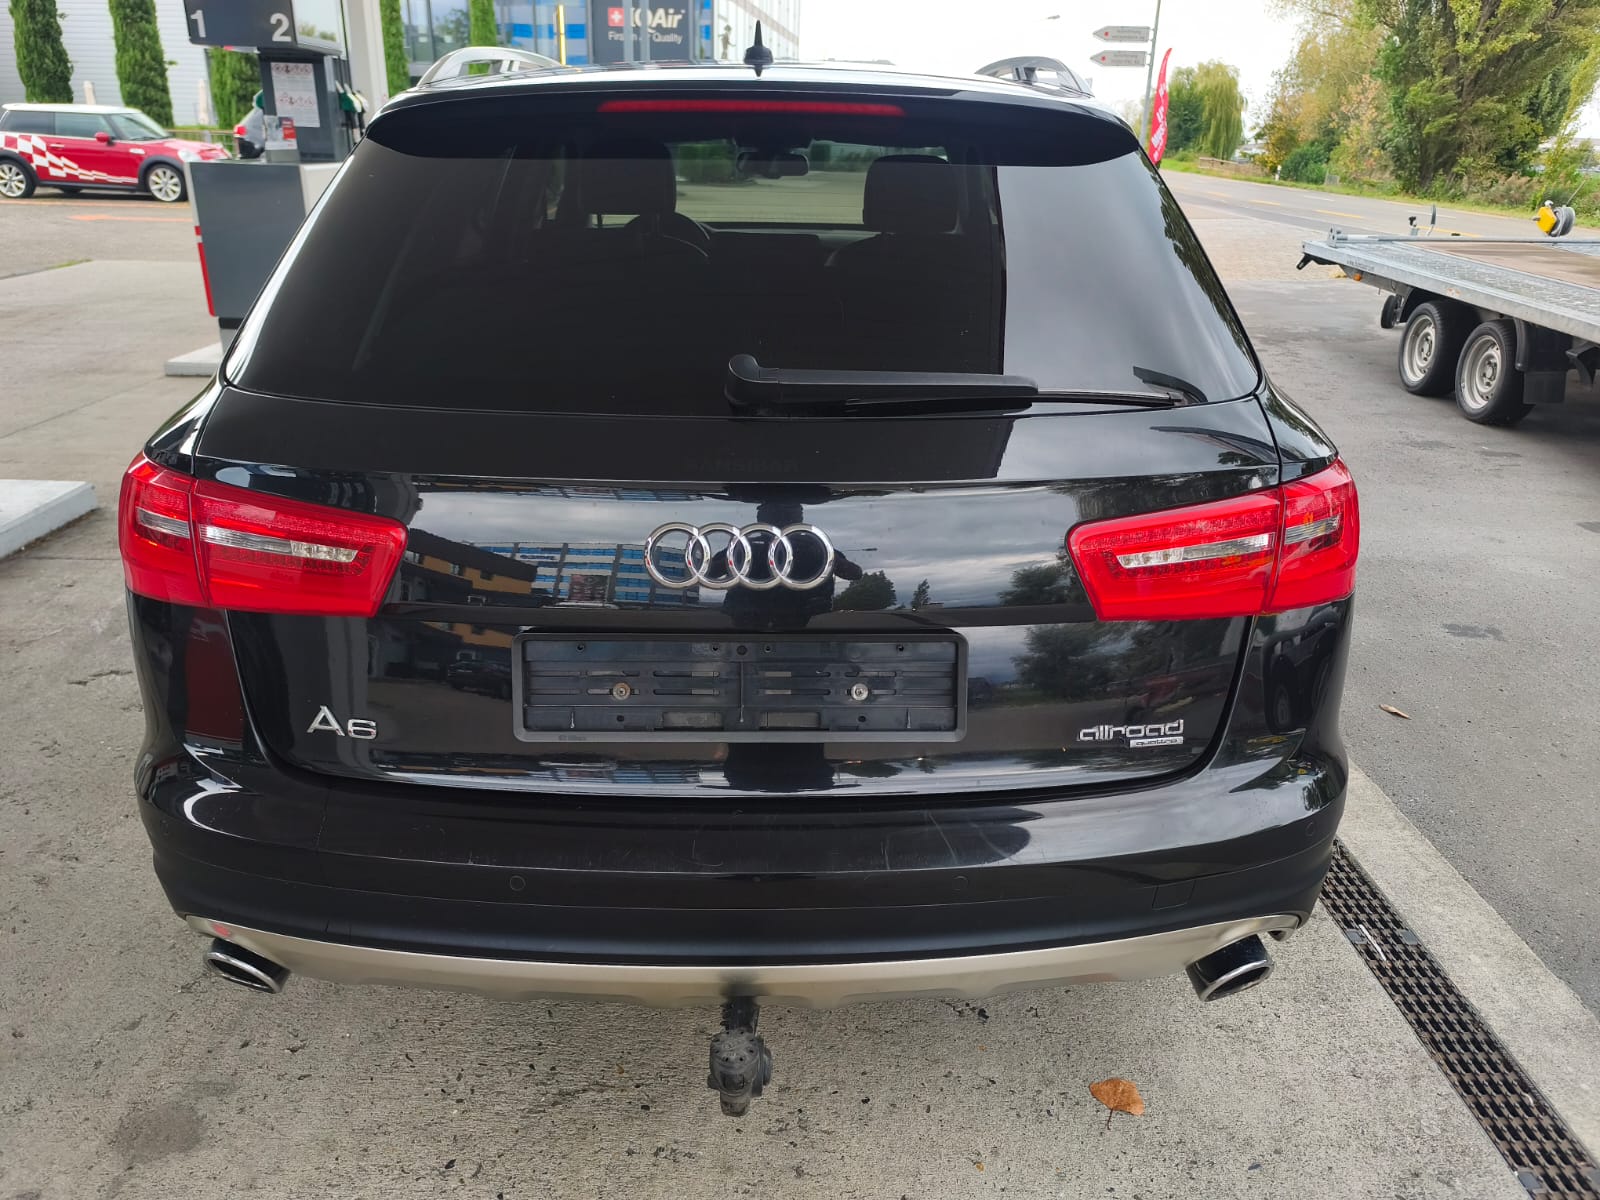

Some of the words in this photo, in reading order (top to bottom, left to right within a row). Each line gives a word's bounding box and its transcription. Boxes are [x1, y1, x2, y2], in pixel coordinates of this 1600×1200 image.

[190, 10, 206, 38] 1
[269, 13, 292, 42] 2
[630, 8, 683, 33] IQAir
[652, 32, 683, 44] Quality
[306, 705, 377, 740] A6
[1079, 719, 1184, 741] allroad
[1135, 738, 1178, 747] quattro
